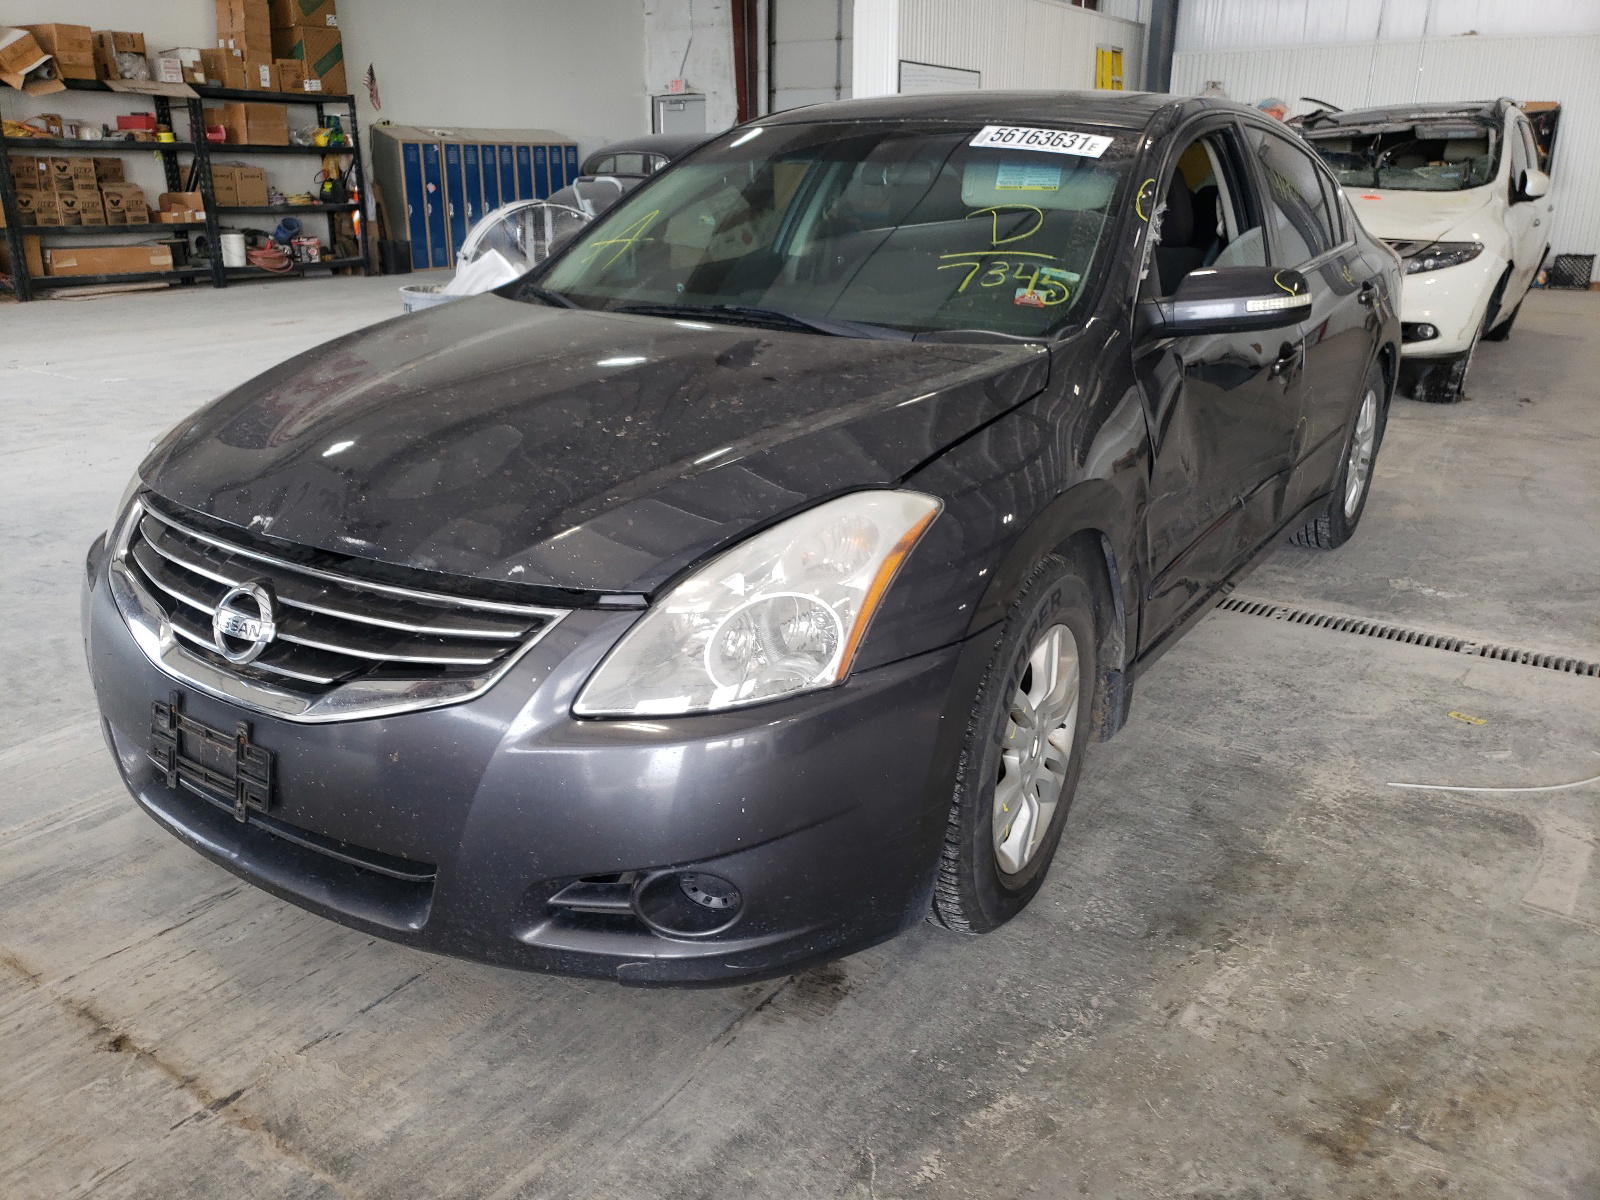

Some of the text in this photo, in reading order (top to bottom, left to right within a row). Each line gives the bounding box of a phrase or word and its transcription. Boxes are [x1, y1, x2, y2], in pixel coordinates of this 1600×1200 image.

[989, 126, 1092, 151] 56163631
[582, 209, 660, 272] A
[965, 203, 1044, 247] D
[937, 261, 1070, 306] 7345
[993, 587, 1063, 746] COOPER
